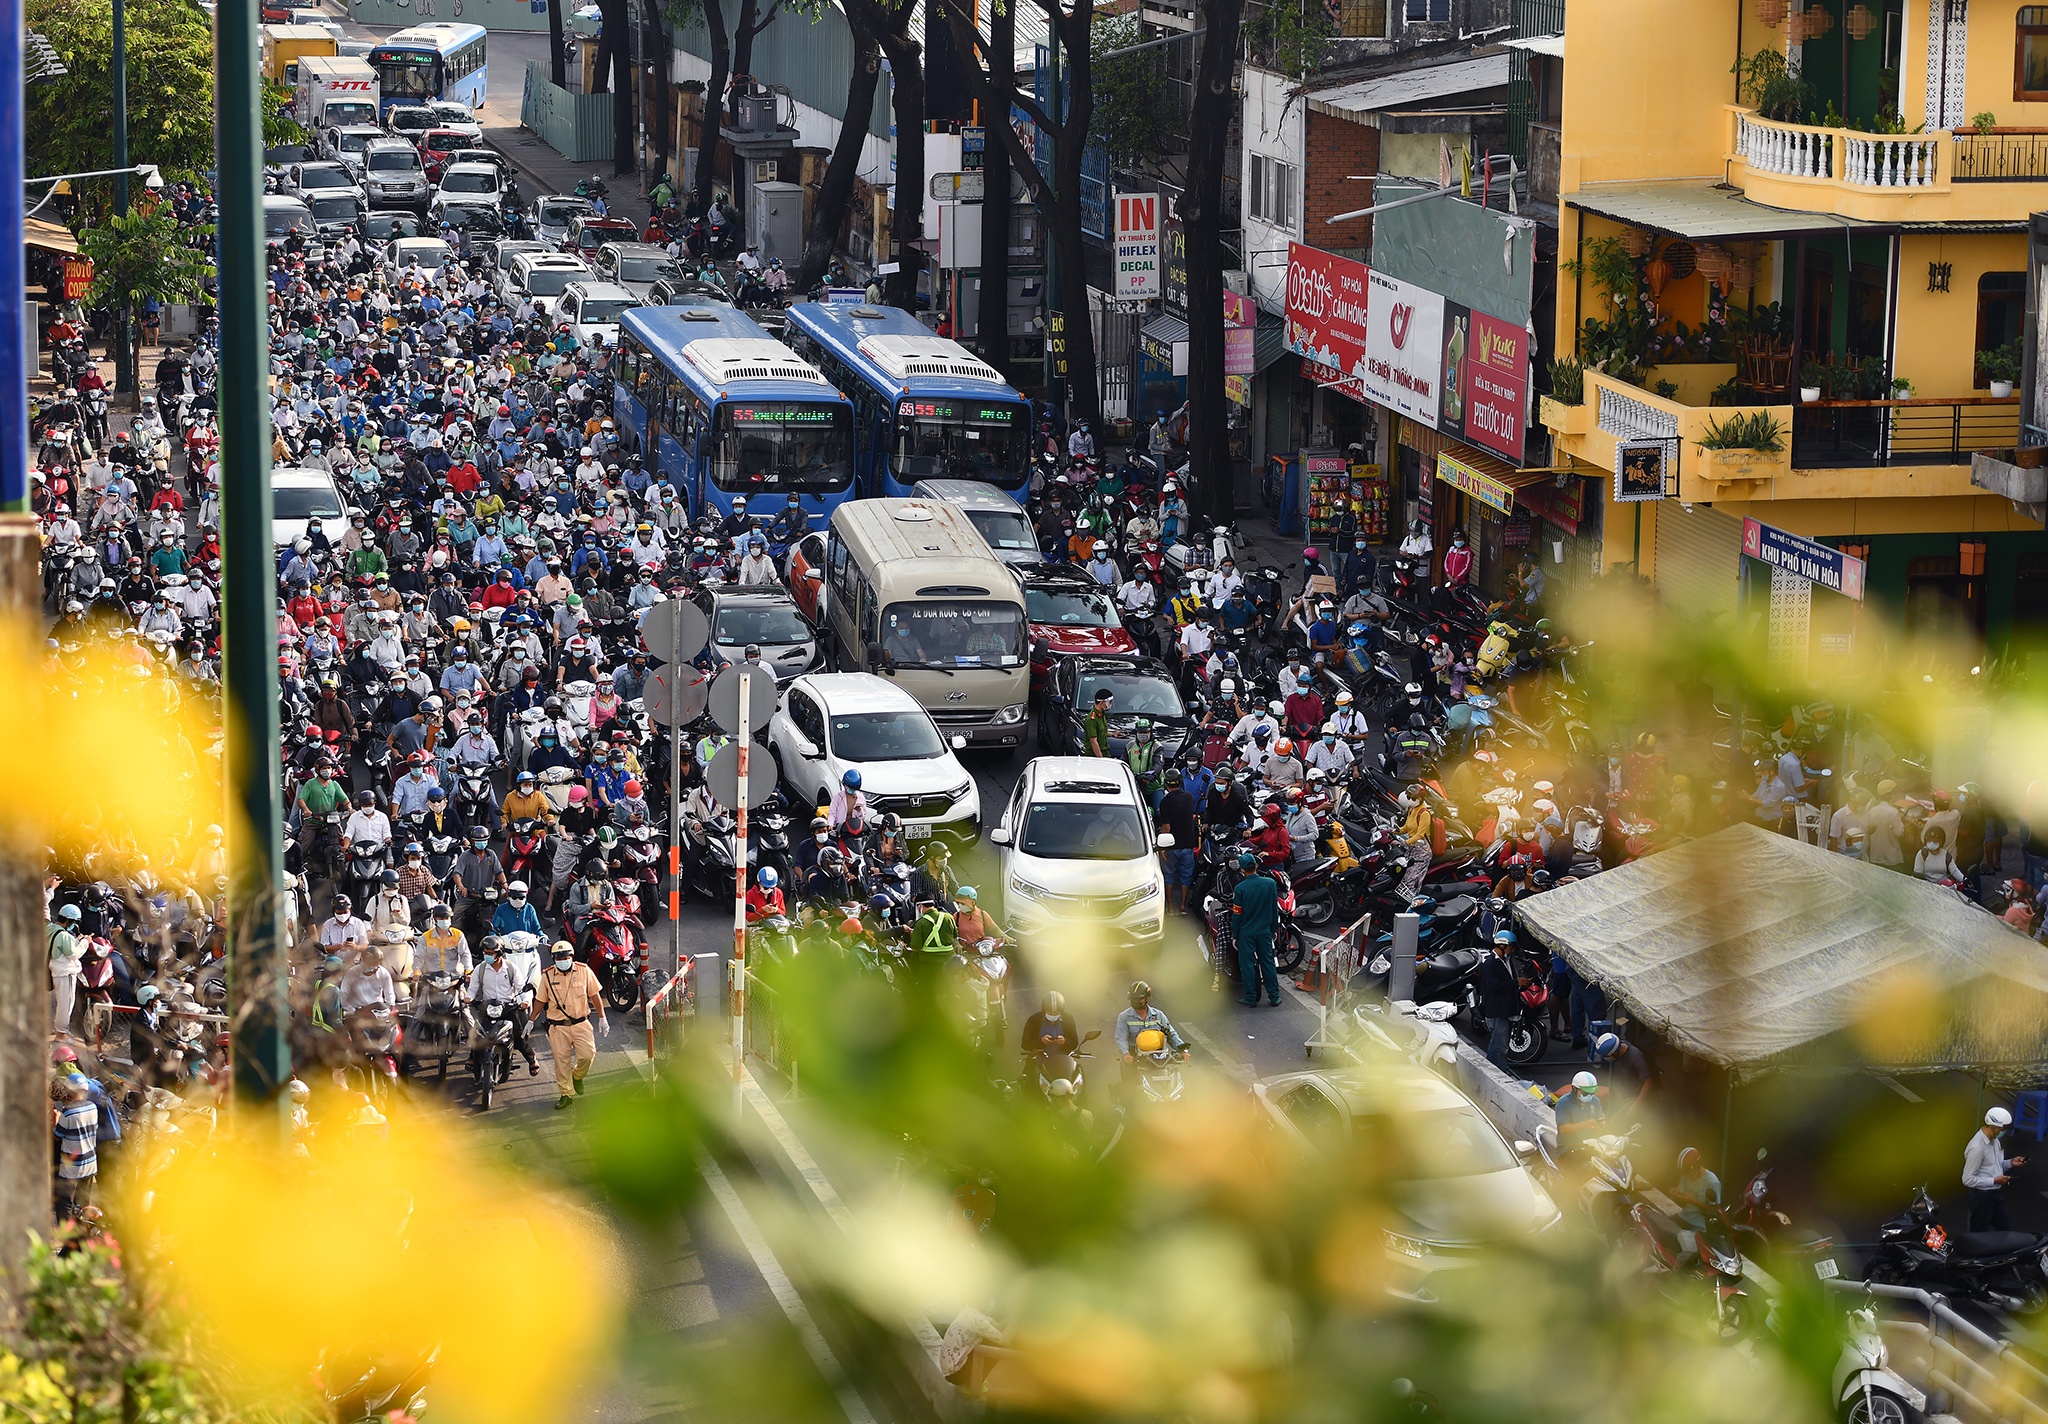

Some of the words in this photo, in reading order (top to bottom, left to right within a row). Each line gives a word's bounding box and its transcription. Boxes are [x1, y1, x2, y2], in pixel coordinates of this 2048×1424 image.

[331, 82, 372, 90] HTL
[1120, 198, 1154, 231] IN
[1119, 245, 1156, 256] HIFLEX
[66, 262, 91, 278] PHOTO
[1121, 261, 1155, 272] DECAL
[1131, 276, 1145, 286] PP
[1341, 276, 1350, 292] TẠP
[1351, 277, 1362, 294] HÓA
[1288, 261, 1325, 318] Oishi
[1313, 361, 1336, 379] TẠP
[1414, 377, 1431, 398] MINH
[733, 410, 754, 420] 55
[901, 404, 913, 414] 55
[915, 404, 935, 415] 55
[1473, 401, 1500, 435] PHƯỚC
[1501, 412, 1515, 445] LỢI
[1624, 448, 1660, 457] INDOCHINE
[1716, 453, 1781, 465] INDOCHINE
[1316, 461, 1338, 470] Oishi
[1458, 470, 1470, 490] ĐỨC
[1761, 543, 1779, 564] KHU
[1781, 551, 1799, 572] PHỐ
[1801, 558, 1819, 580] VĂN
[1821, 566, 1839, 589] HÓA
